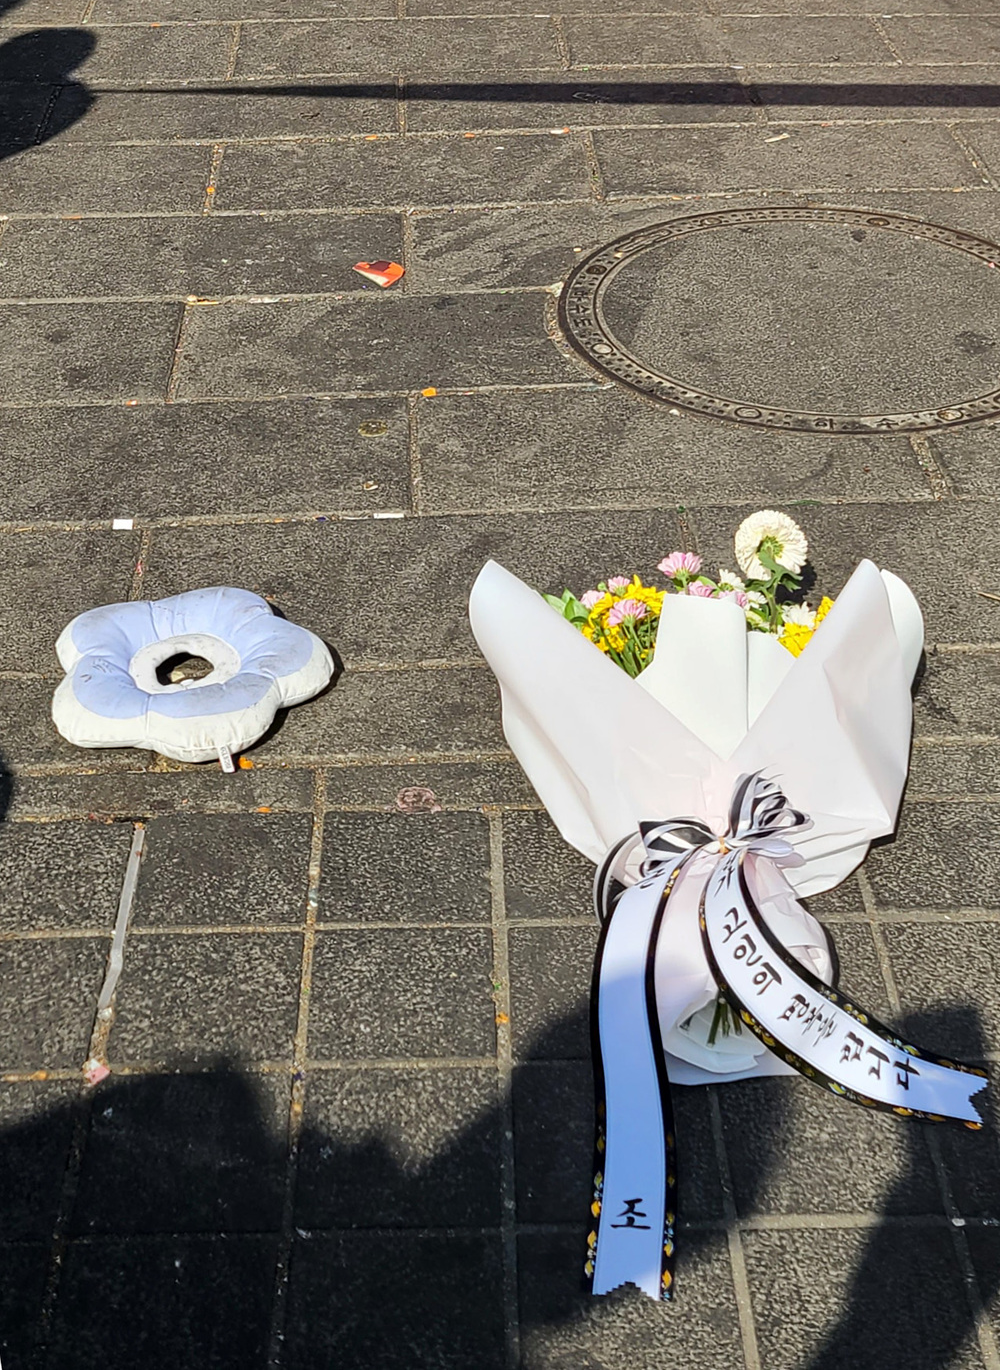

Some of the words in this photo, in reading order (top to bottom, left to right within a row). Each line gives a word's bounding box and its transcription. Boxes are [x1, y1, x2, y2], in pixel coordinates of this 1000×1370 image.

[722, 907, 783, 996] 고인의
[840, 1031, 921, 1091] 빕니다
[610, 1197, 651, 1231] 조
